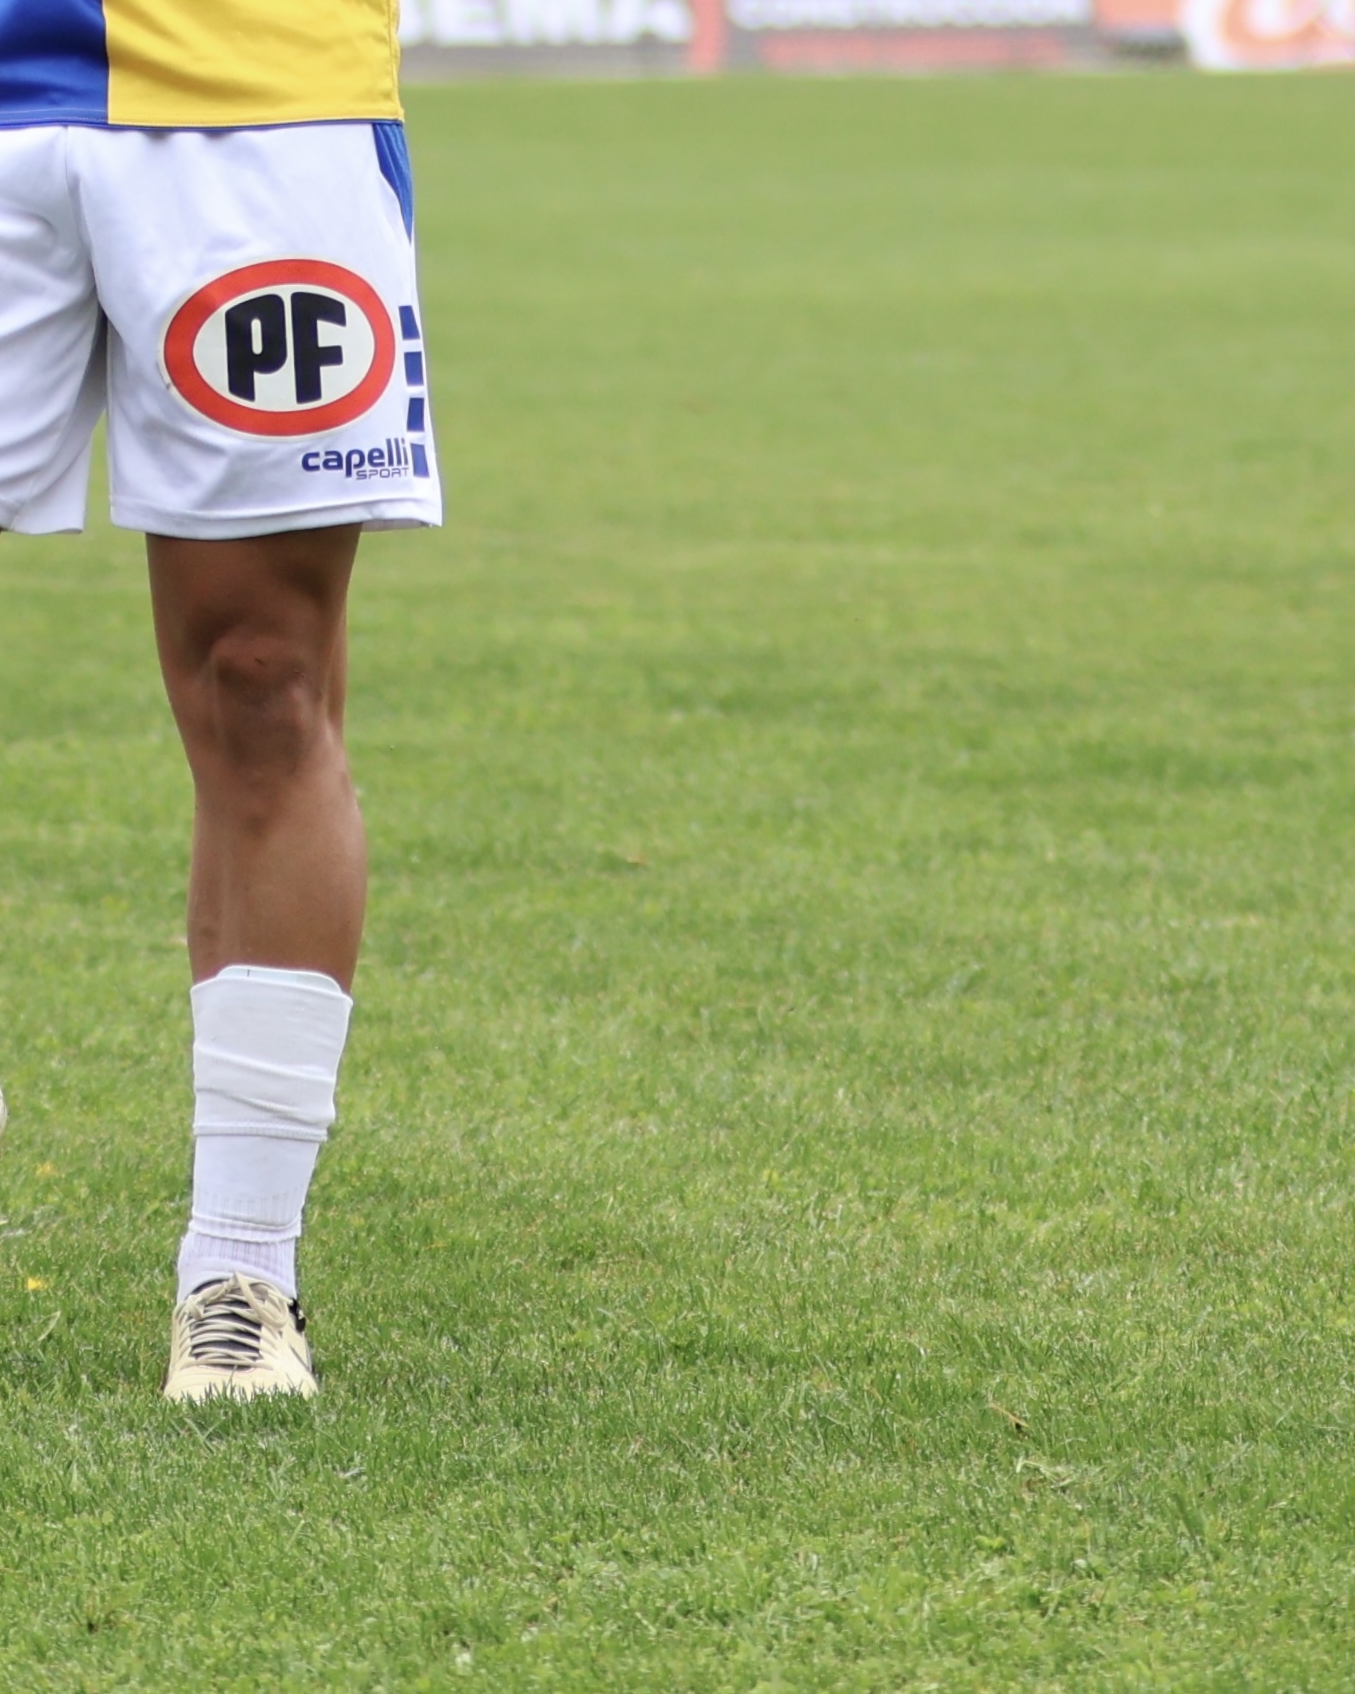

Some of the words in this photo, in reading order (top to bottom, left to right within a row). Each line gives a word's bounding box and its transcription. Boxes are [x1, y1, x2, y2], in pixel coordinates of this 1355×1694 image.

[223, 292, 347, 405] PF
[301, 437, 409, 478] capelli
[356, 467, 409, 480] SPORT
